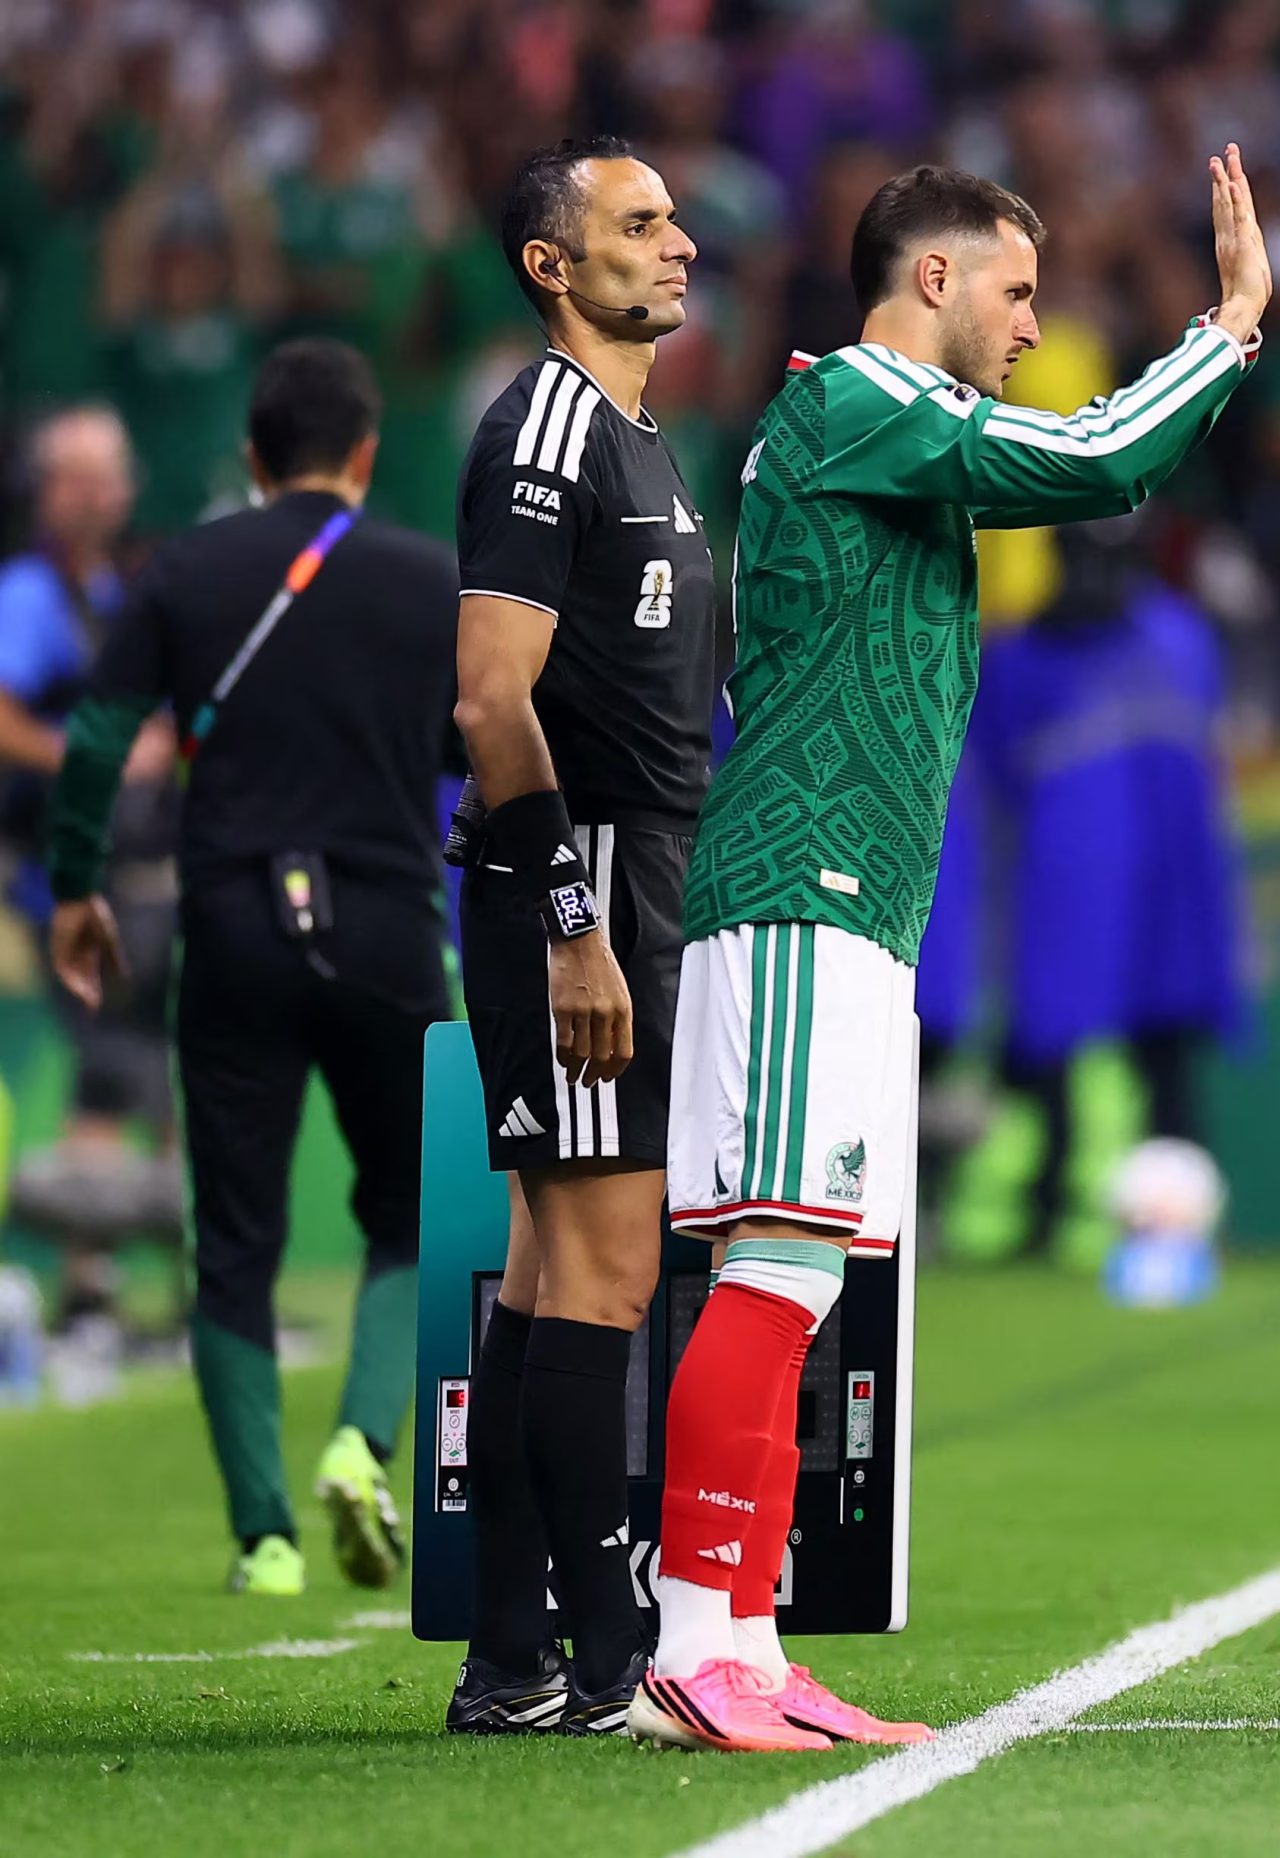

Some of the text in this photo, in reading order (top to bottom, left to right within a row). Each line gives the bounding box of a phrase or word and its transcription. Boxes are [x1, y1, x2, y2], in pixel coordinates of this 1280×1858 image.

[513, 481, 561, 511] FIFA
[511, 505, 559, 526] TEAM ONE
[643, 613, 661, 621] FIFA
[557, 887, 587, 930] 73:03
